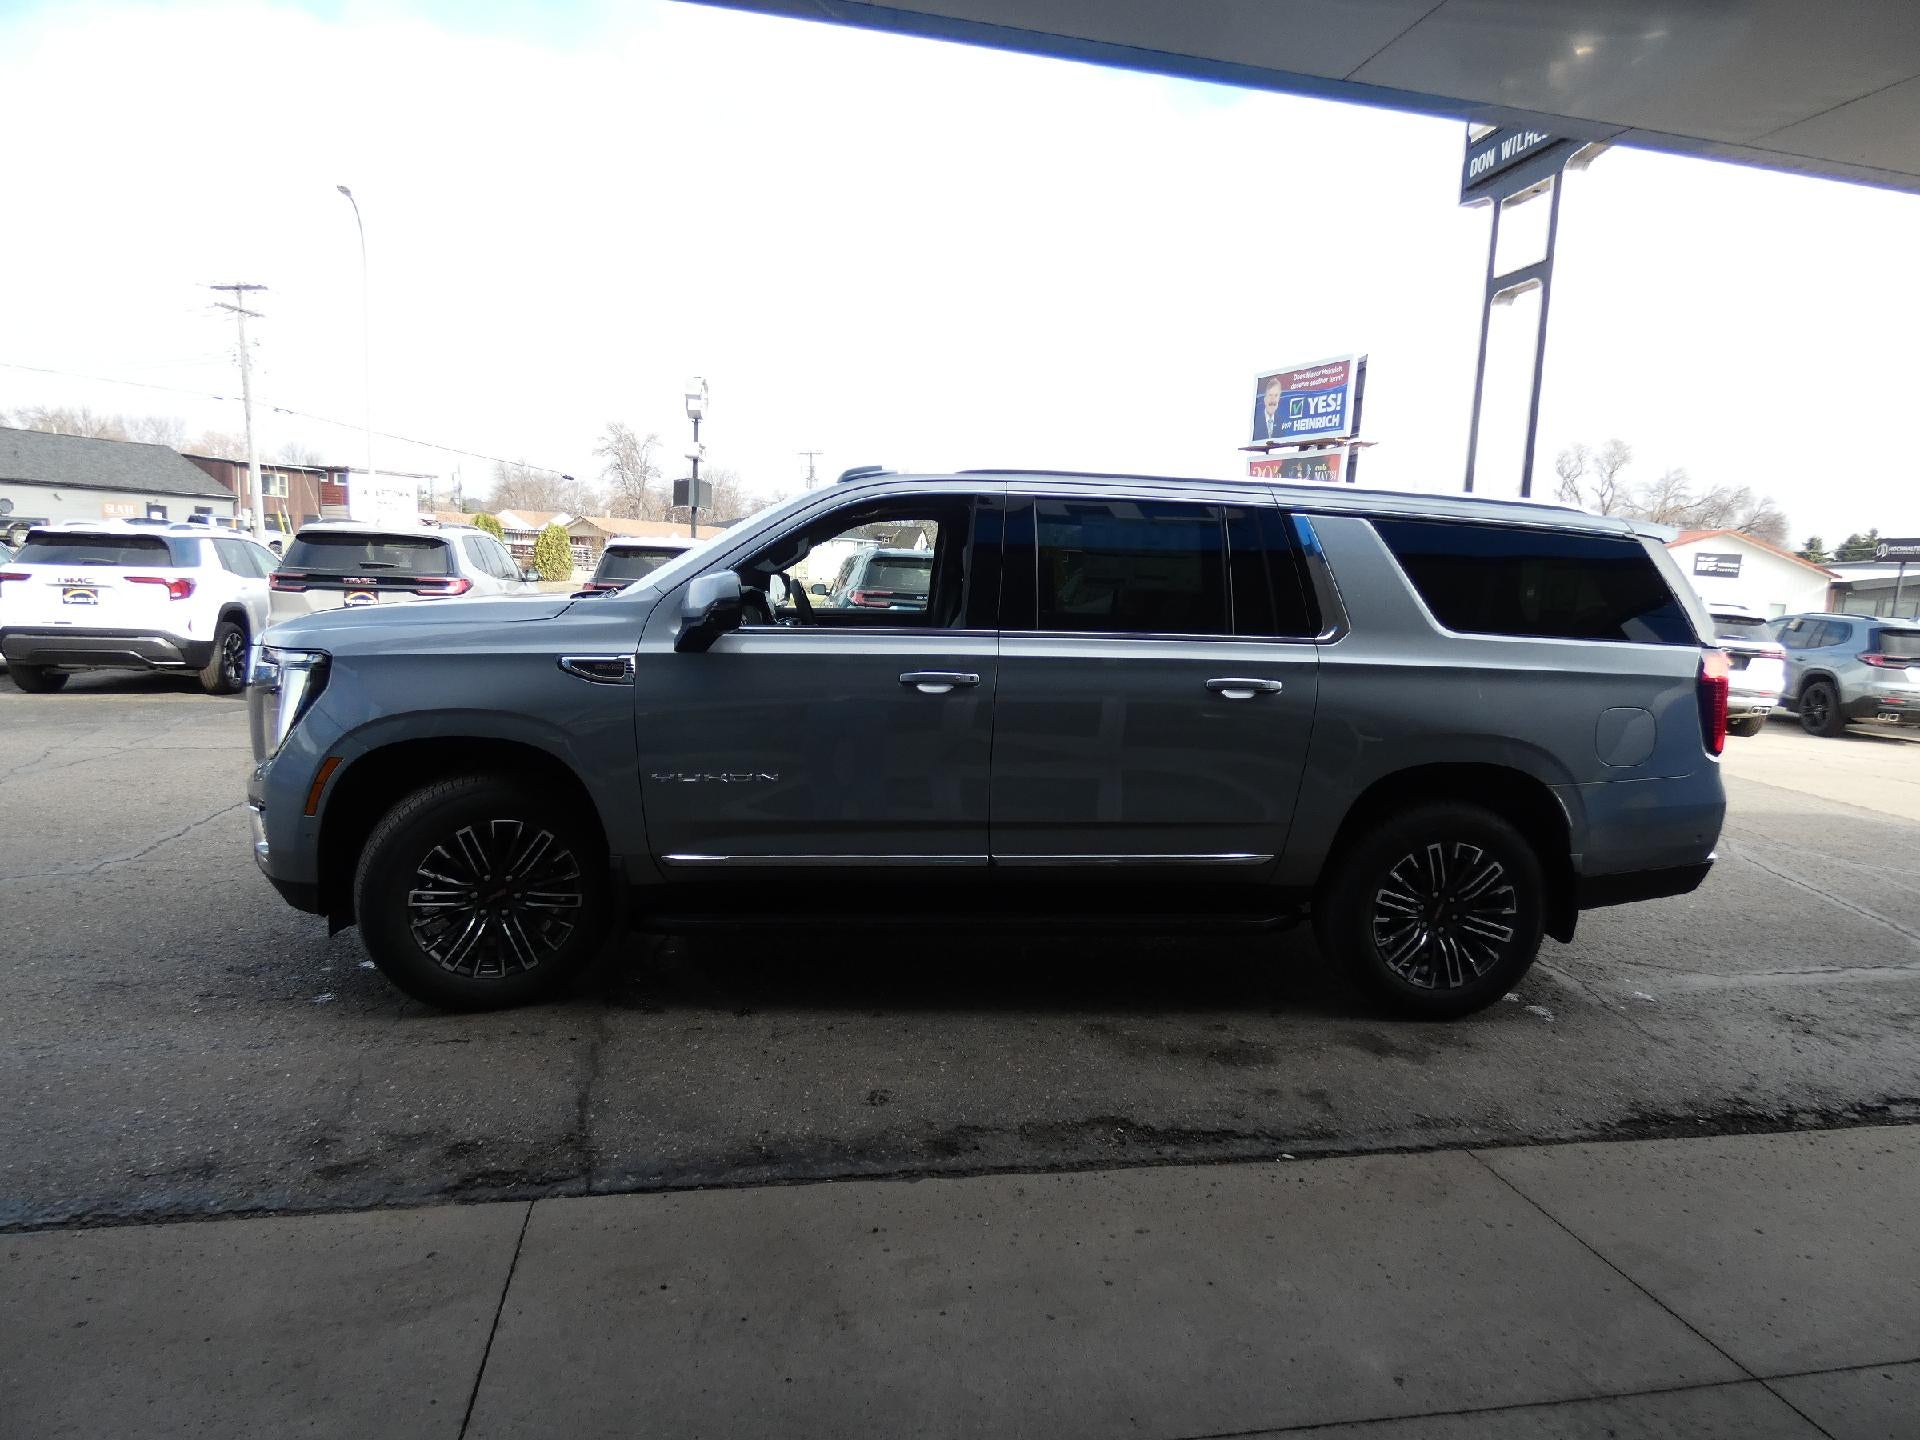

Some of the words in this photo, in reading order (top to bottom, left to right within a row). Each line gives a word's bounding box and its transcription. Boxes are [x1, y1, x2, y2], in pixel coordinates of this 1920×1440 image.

[1469, 147, 1496, 178] DON
[1307, 393, 1342, 415] YES!
[1293, 414, 1340, 431] HEINRICH
[651, 773, 779, 783] YUKON
